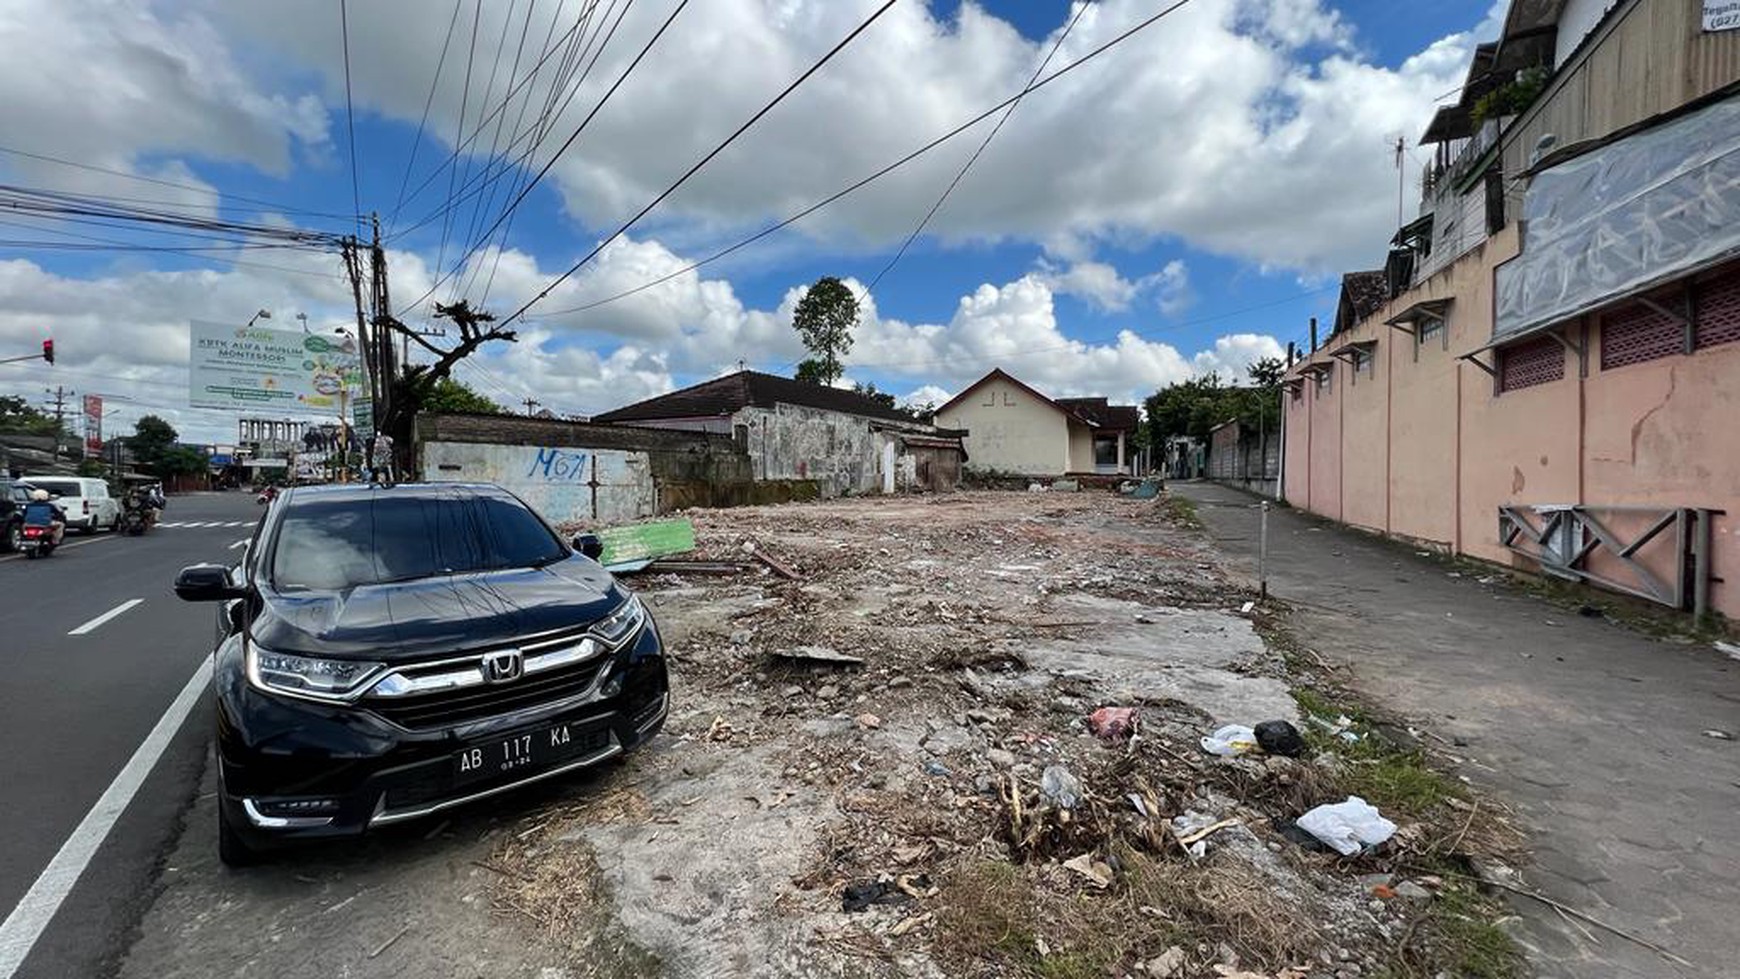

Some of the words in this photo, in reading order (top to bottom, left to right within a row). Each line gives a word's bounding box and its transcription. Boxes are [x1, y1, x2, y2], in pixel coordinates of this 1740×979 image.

[1711, 13, 1740, 29] (027
[232, 342, 261, 351] ALIFA
[265, 346, 304, 355] MUSLIM
[461, 748, 482, 772] AB
[503, 735, 531, 760] 117
[551, 725, 570, 746] KA
